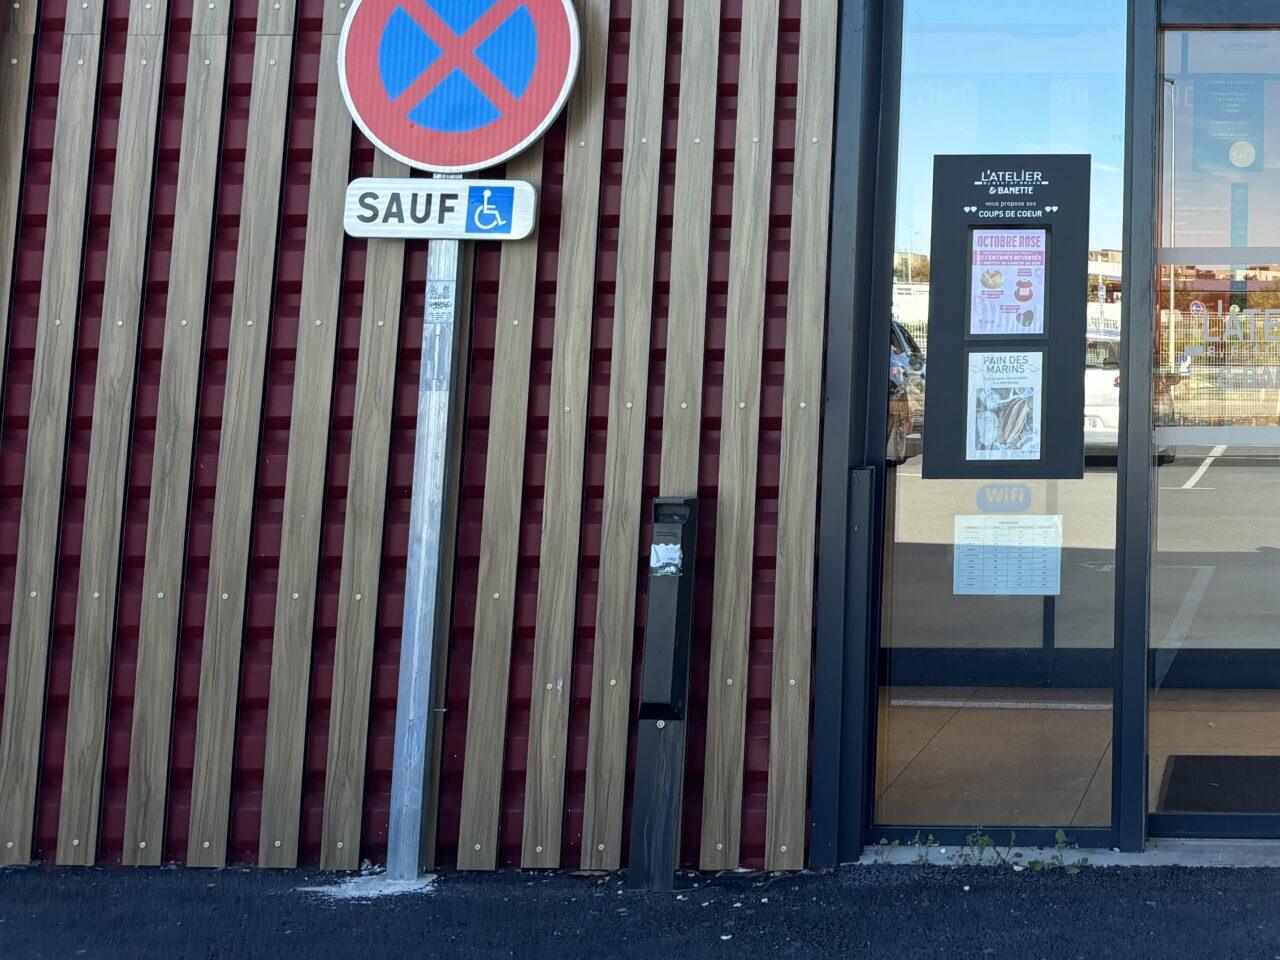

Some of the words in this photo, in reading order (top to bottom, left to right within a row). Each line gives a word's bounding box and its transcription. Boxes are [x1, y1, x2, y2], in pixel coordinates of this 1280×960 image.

[997, 187, 1034, 195] BANETTE
[356, 191, 459, 224] SAUF
[978, 210, 1004, 218] COUPS
[1005, 210, 1015, 218] DE
[1017, 210, 1043, 218] COEUR
[977, 235, 1017, 248] OCTOBRE
[1019, 235, 1041, 248] ROSE
[983, 355, 1007, 365] PAIN
[1009, 355, 1029, 365] DES
[986, 364, 1025, 374] MARINS
[984, 487, 1024, 503] Wifi
